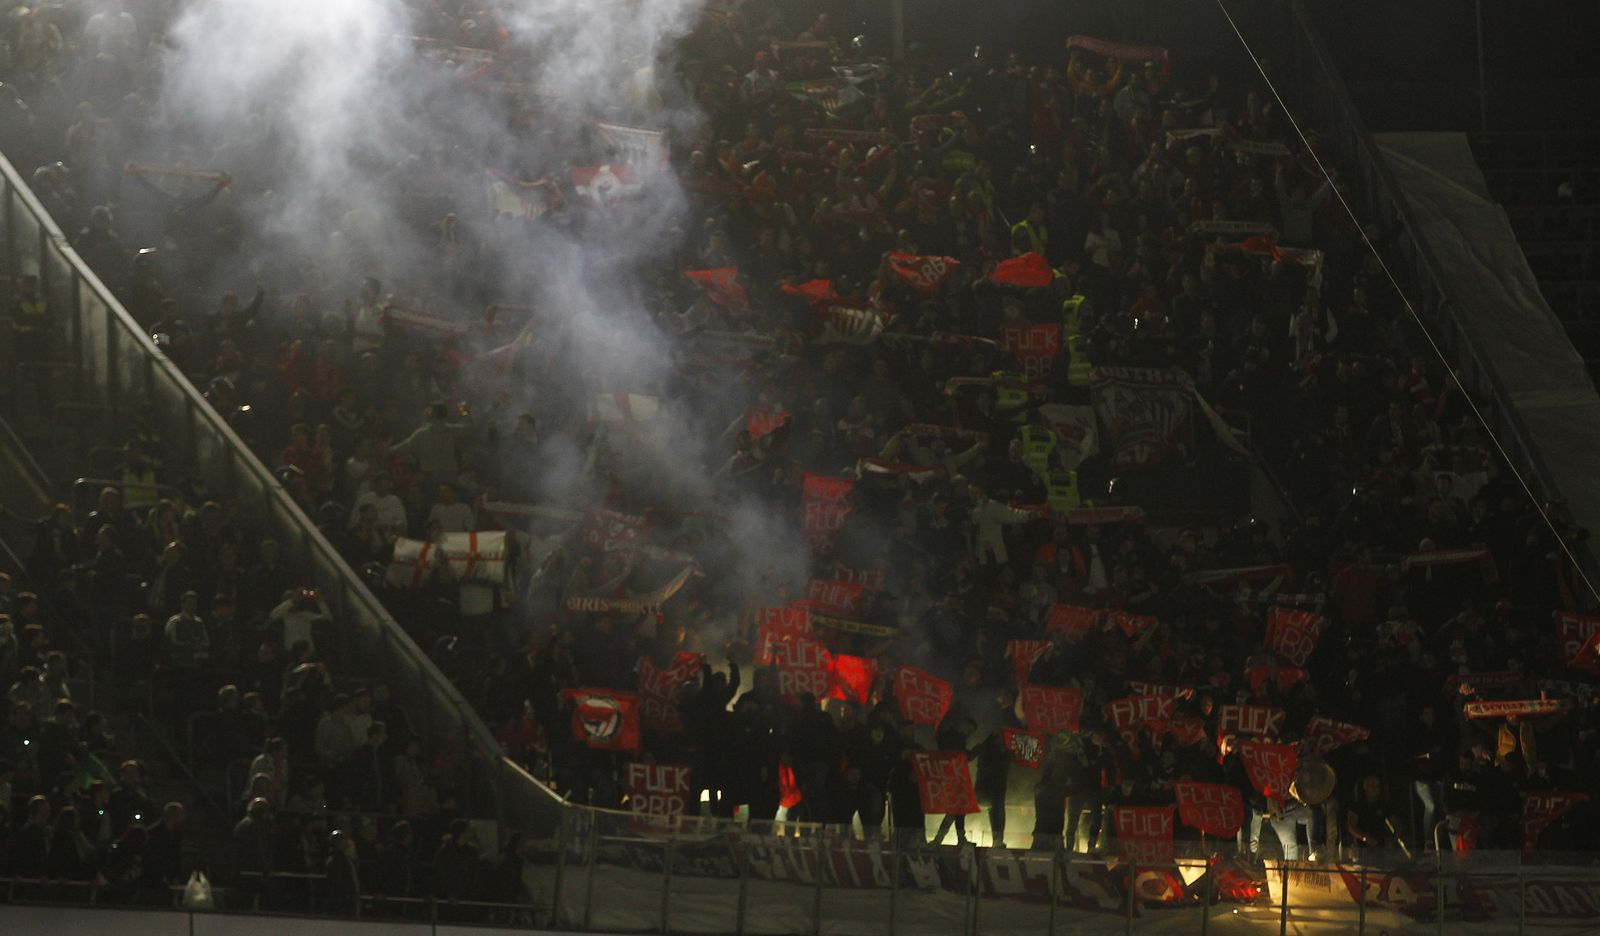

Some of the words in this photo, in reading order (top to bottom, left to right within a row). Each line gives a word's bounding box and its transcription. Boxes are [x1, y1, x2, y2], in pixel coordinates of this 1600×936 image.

[1004, 327, 1057, 352] FUCK
[810, 579, 861, 610] FUCK
[774, 636, 833, 670] FUCK
[1112, 697, 1173, 727] FUCK
[1222, 705, 1286, 735] FUCK
[629, 763, 690, 793] FUCK
[915, 753, 967, 783] FUCK
[1176, 783, 1237, 806] FUCK
[1119, 809, 1173, 837] FUCK
